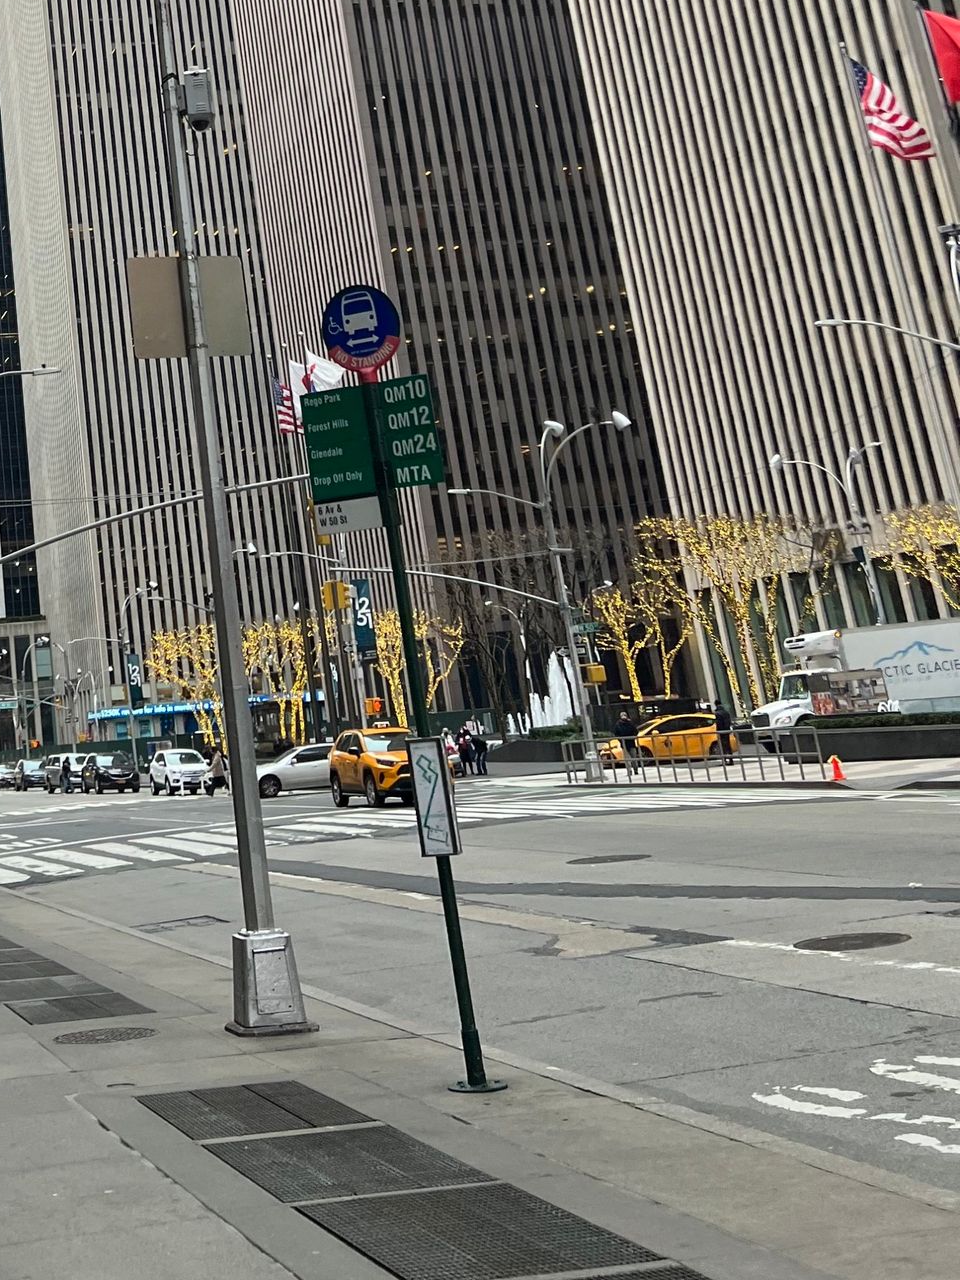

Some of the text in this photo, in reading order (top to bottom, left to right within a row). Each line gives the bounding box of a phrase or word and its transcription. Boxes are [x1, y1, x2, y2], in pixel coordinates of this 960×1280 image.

[334, 342, 394, 368] NO STANDING
[384, 379, 426, 403] QM10
[304, 394, 341, 407] Rego Park
[388, 405, 431, 430] QM12
[307, 419, 349, 433] Forest Hills
[392, 432, 437, 457] QM24
[311, 447, 343, 459] Glendale
[313, 471, 363, 486] Drop Off Only
[396, 464, 432, 484] MTA
[318, 506, 323, 515] 6
[325, 505, 334, 514] Av
[320, 515, 348, 527] W 50 St
[356, 610, 373, 629] 51
[128, 663, 139, 676] 12
[883, 664, 913, 677] CTIC
[130, 674, 141, 687] 51
